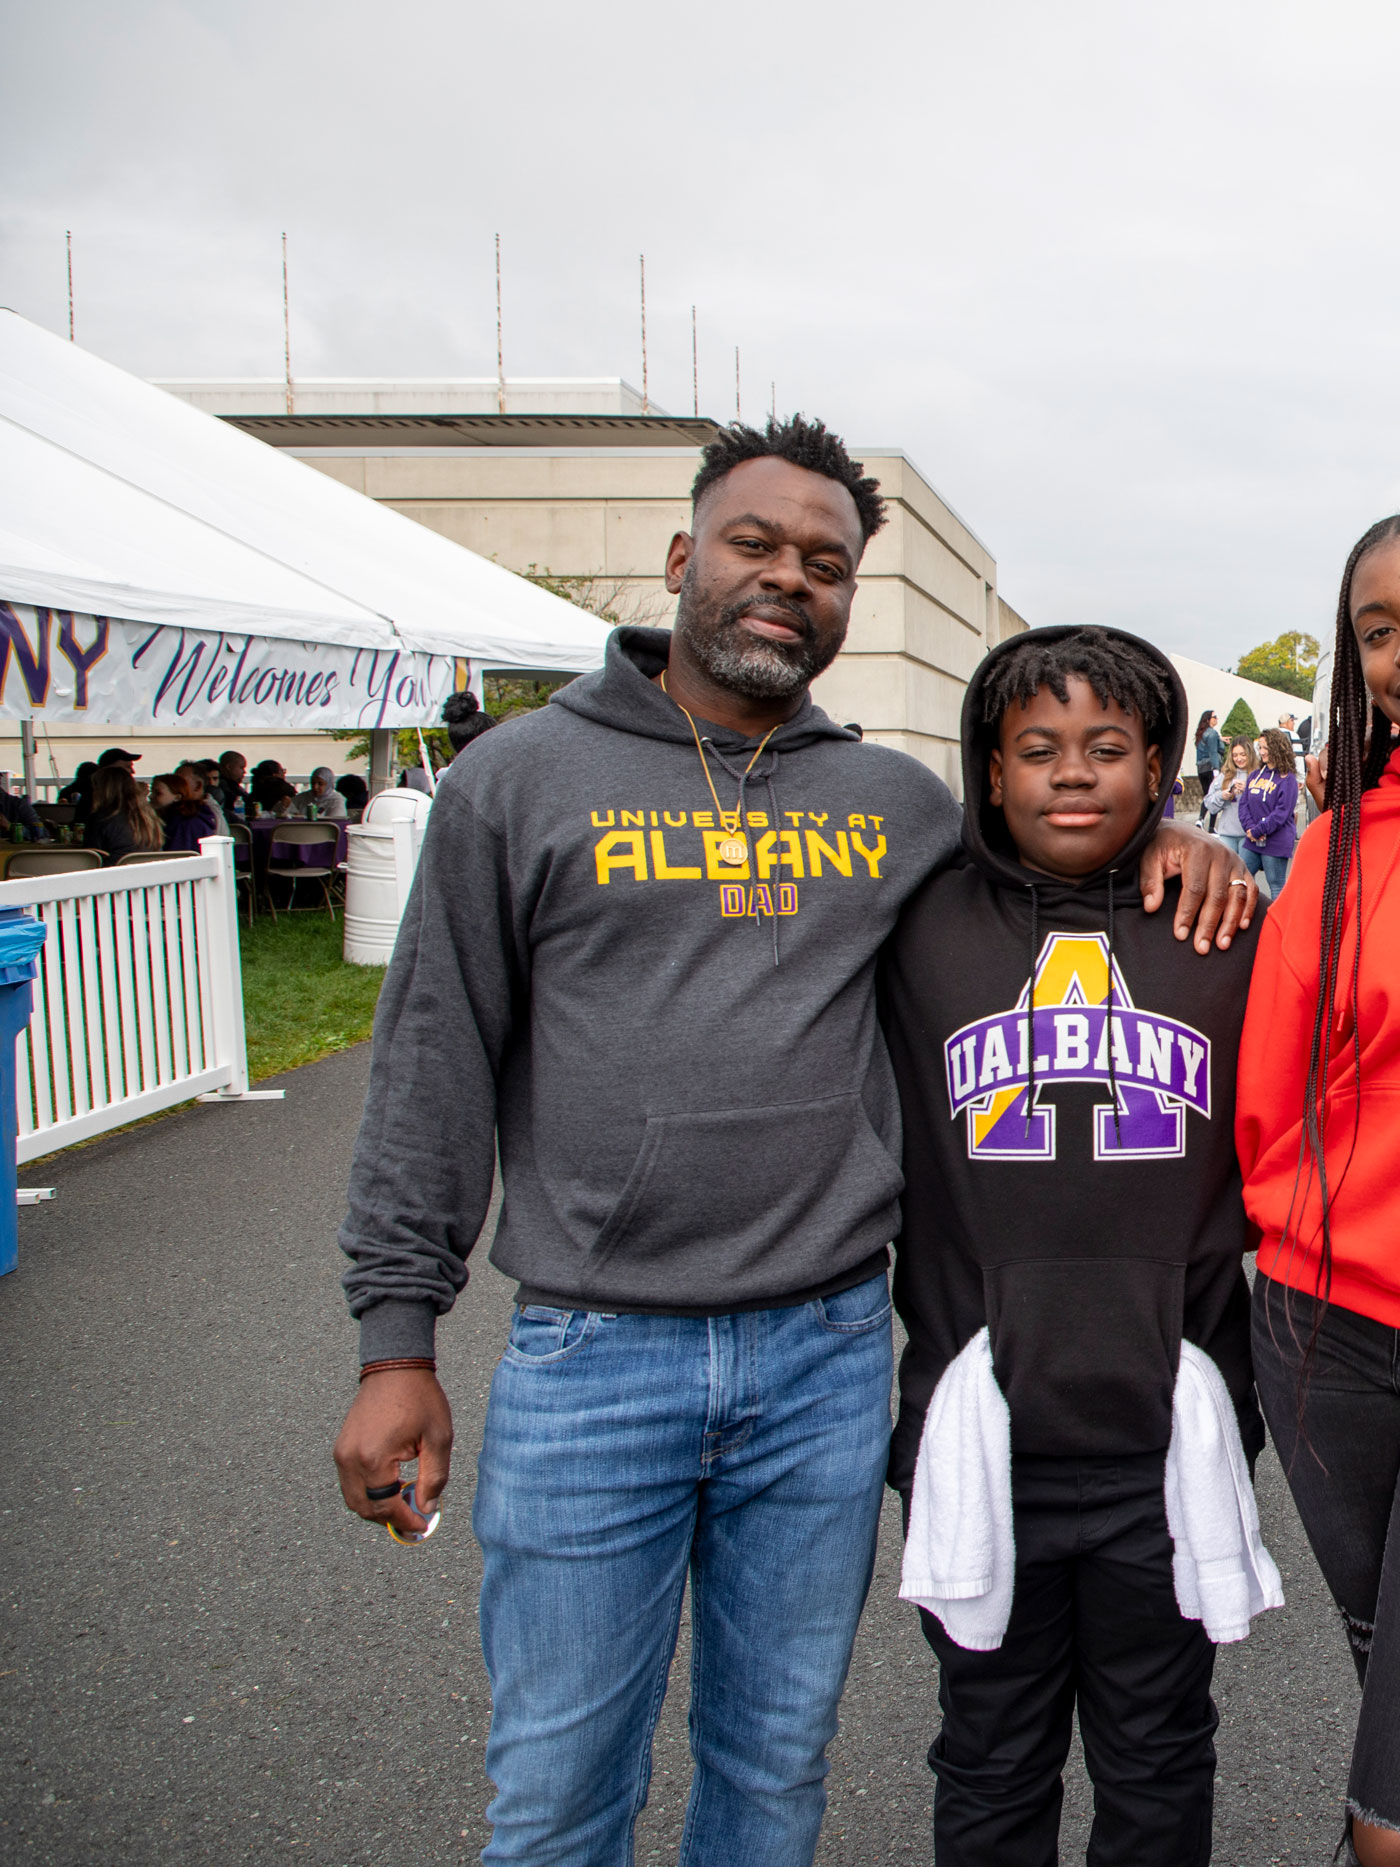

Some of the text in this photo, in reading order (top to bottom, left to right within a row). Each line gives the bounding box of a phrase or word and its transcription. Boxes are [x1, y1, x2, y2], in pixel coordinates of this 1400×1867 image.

[132, 624, 340, 718] Welcomes
[590, 810, 884, 830] UNIVERSTY AT
[594, 830, 888, 885] ALBANY
[720, 882, 798, 918] DAD
[950, 1013, 1205, 1101] UALBANY
